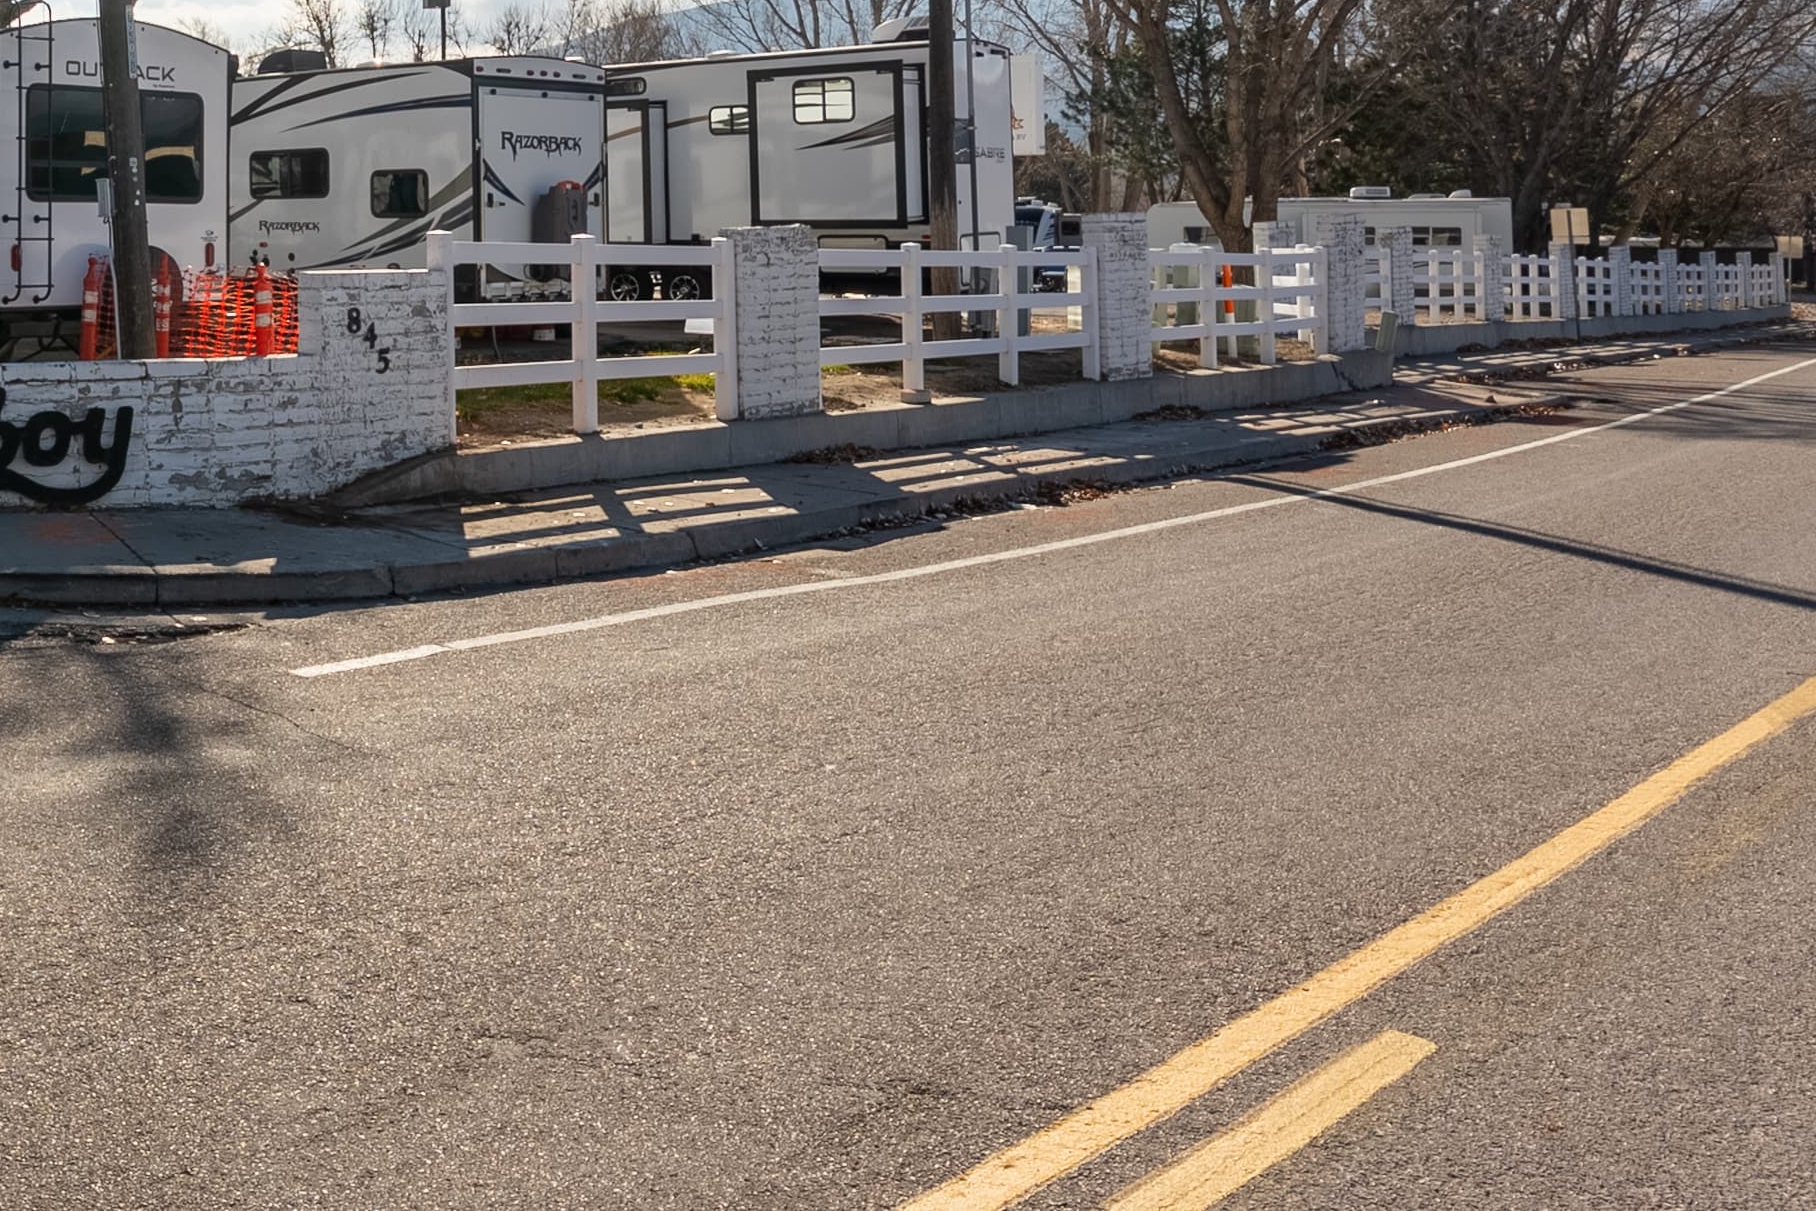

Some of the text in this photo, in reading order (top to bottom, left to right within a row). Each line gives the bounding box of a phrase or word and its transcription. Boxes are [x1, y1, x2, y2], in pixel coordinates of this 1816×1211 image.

[66, 59, 176, 82] OUACK
[501, 131, 582, 162] RAZORBACK
[259, 220, 320, 238] RAZORBACK
